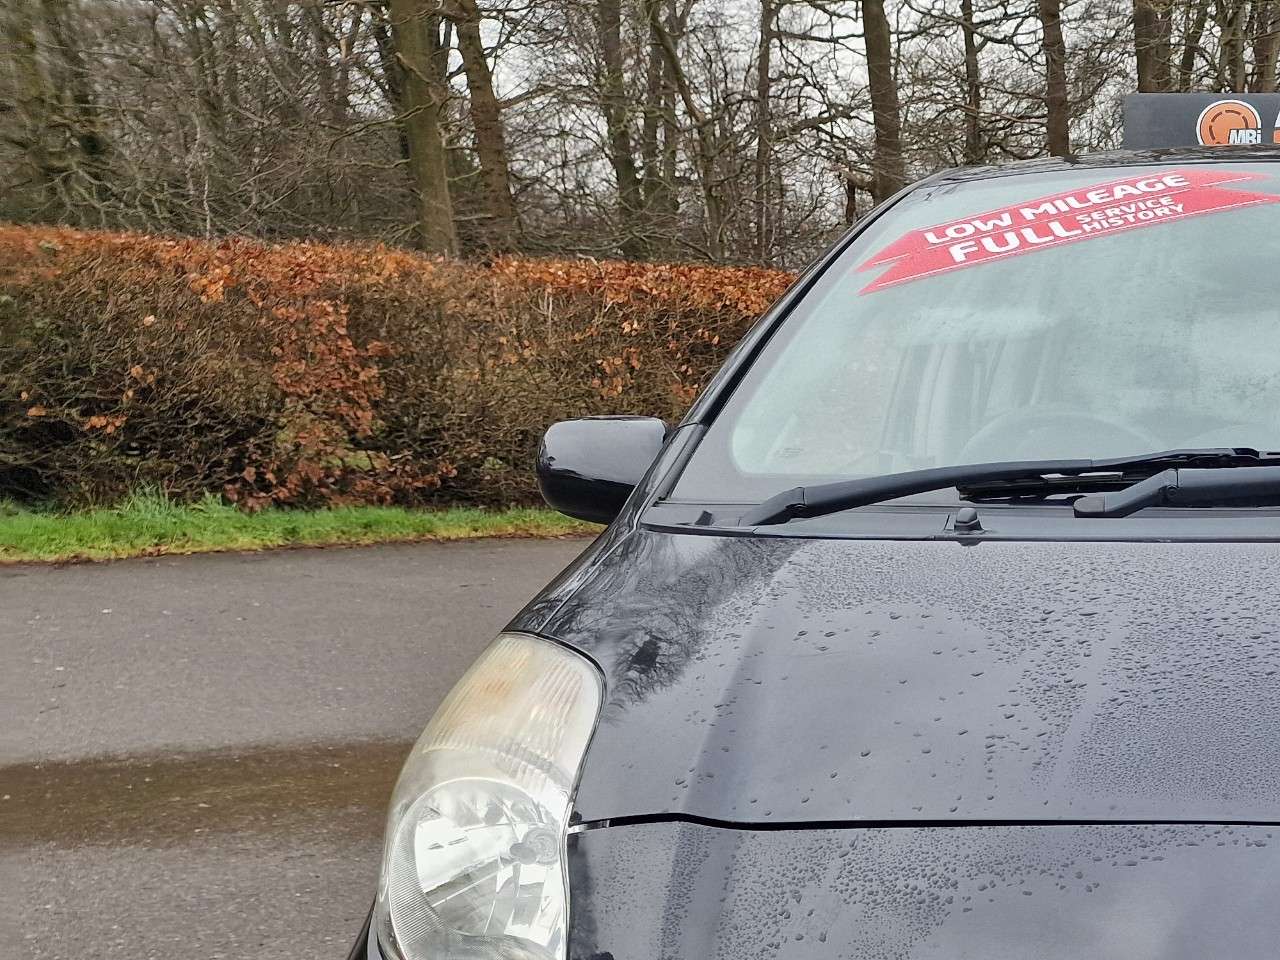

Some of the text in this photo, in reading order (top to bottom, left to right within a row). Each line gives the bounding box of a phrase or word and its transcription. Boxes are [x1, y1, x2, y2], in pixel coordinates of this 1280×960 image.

[923, 174, 1191, 247] LOW MILEAGE
[1076, 196, 1175, 225] SERVICE
[1081, 203, 1185, 233] HISTORY
[947, 220, 1083, 263] FULL
